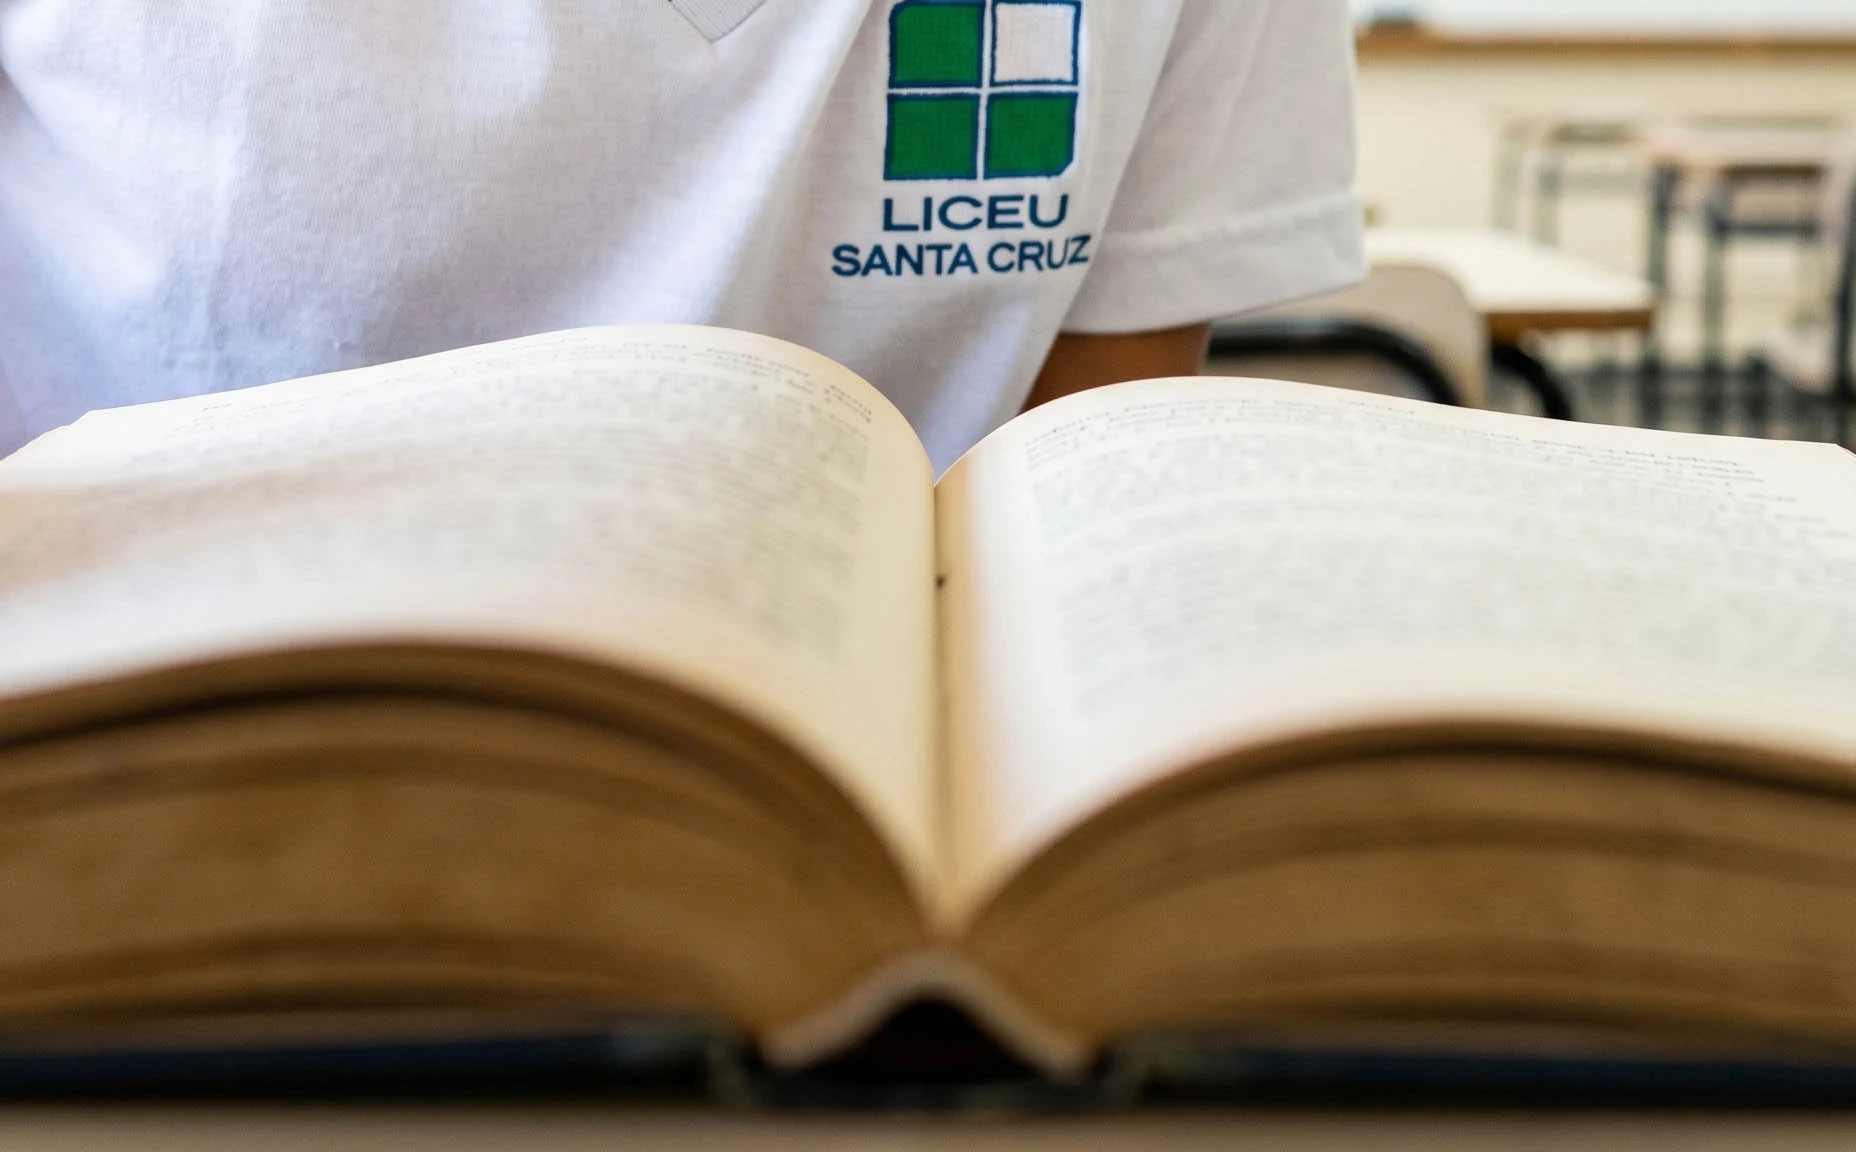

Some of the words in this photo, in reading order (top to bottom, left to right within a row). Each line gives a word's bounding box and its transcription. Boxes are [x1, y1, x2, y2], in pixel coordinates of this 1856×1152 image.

[883, 194, 1069, 231] LICEU
[831, 243, 978, 276] SANTA
[987, 234, 1092, 273] CRUZ
